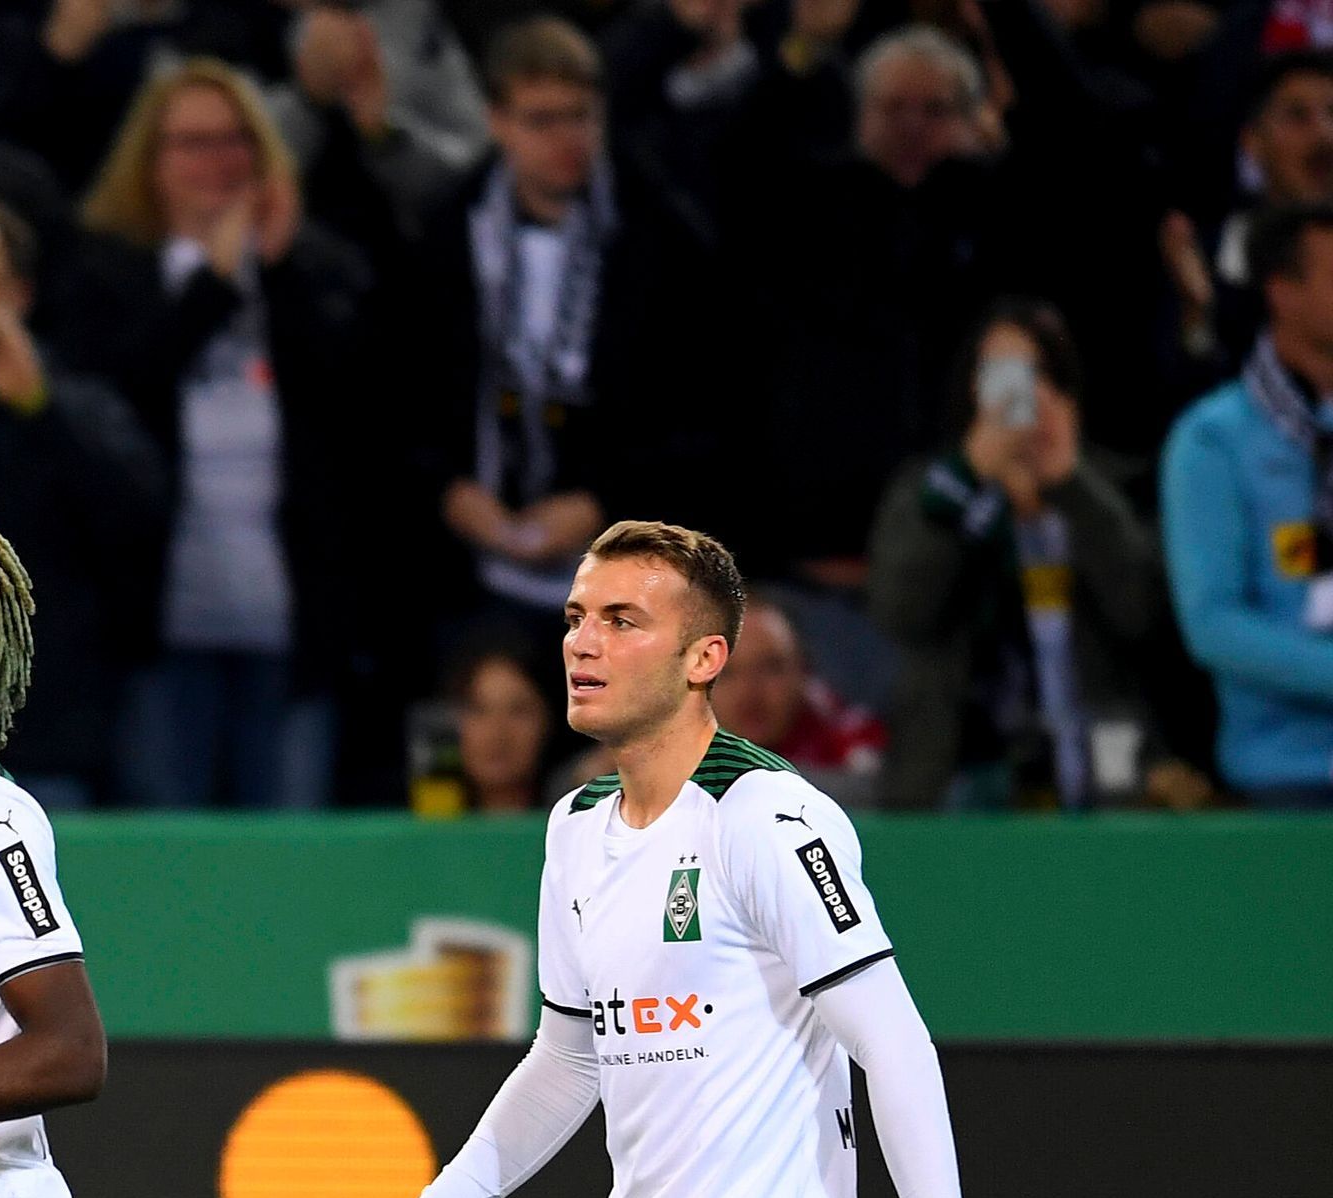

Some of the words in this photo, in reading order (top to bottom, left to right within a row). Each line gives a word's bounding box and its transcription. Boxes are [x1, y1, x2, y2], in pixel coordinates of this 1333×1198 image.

[7, 849, 51, 928] Sonepar
[805, 846, 853, 923] Sonepar
[637, 1046, 710, 1064] HANDELN.
